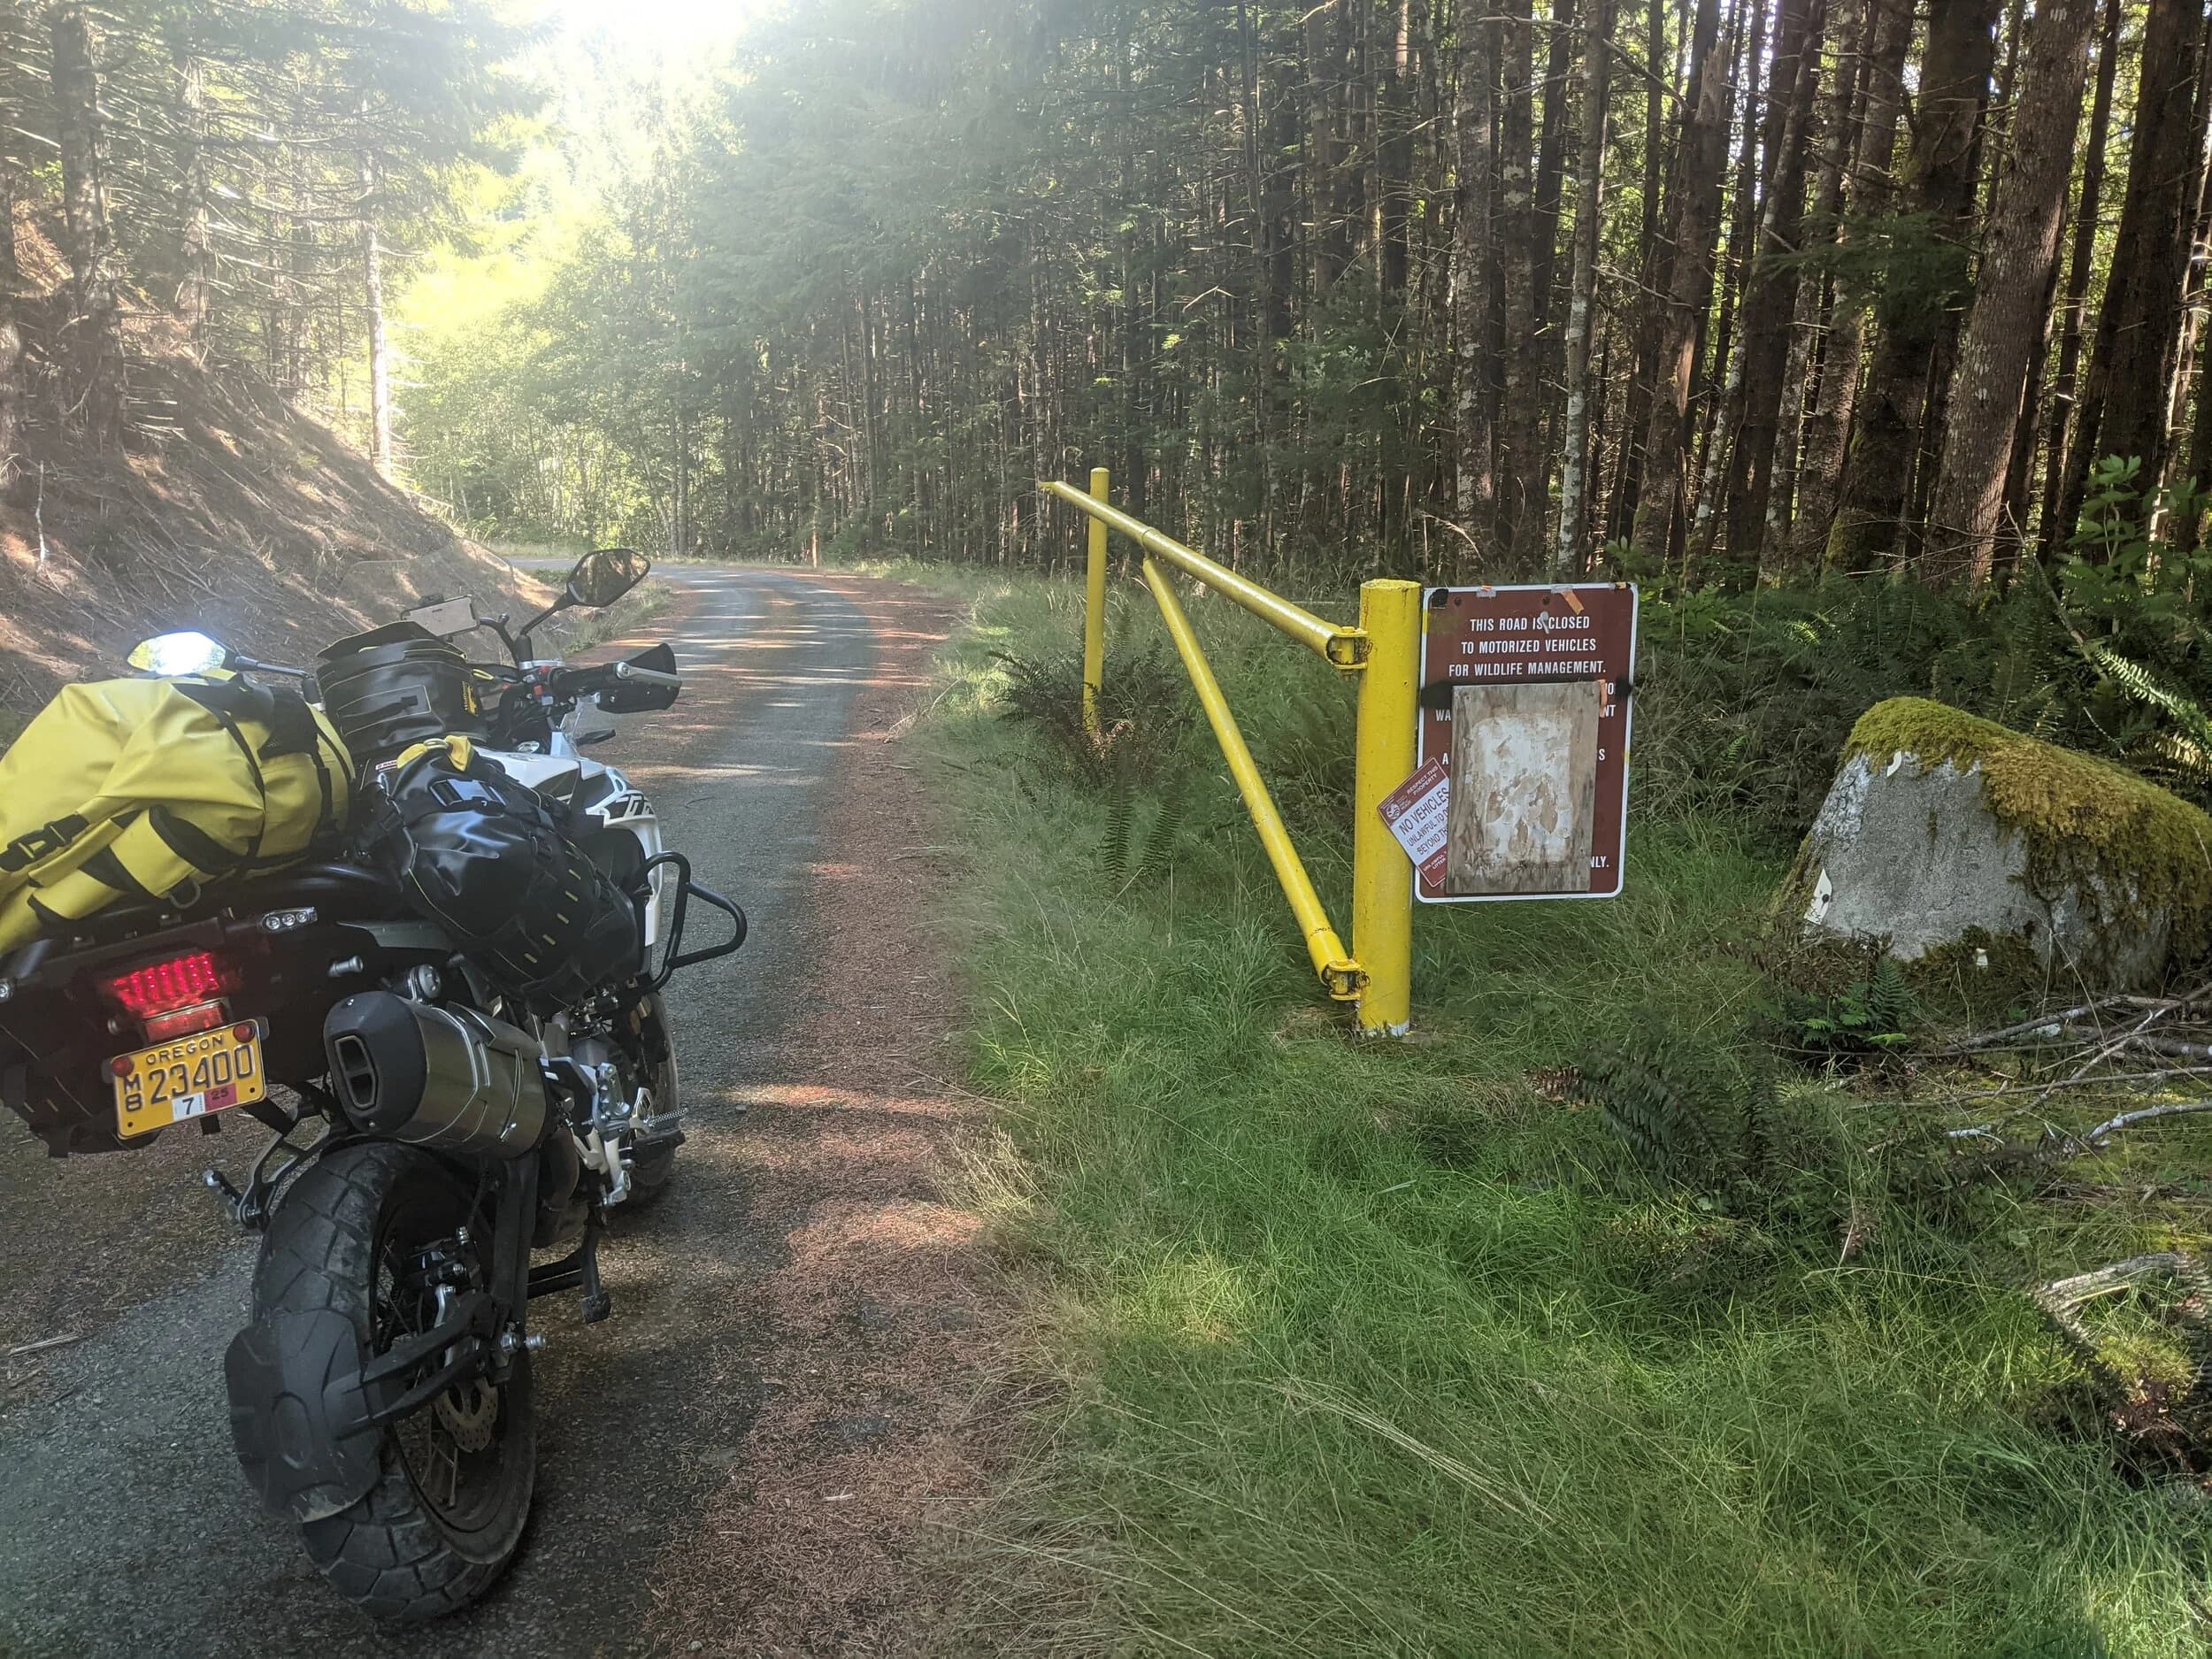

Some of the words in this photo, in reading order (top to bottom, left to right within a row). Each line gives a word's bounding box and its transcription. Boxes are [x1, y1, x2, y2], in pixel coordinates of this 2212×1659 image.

[1470, 618, 1494, 632] THIS
[1499, 617, 1528, 631] ROAD
[1532, 617, 1543, 630] IS
[1548, 616, 1590, 629] CLOSED
[1461, 641, 1474, 655] TO
[1479, 639, 1540, 654] MOTORIZED
[1545, 638, 1596, 652] VEHICLES
[1448, 664, 1469, 677] FOR
[1474, 662, 1523, 676] WILDLIFE
[1528, 661, 1607, 675] MANAGEMENT.
[1407, 773, 1427, 795] RESPECT
[1412, 772, 1438, 796] PROPERTY
[1399, 818, 1414, 835] NO
[1410, 787, 1449, 824] VEHICLES
[1407, 820, 1438, 847] UNLAWFUL
[1433, 813, 1445, 824] TO
[1417, 833, 1440, 856] BEYOND
[146, 1033, 225, 1065] OREGON
[148, 1044, 255, 1105] 23400
[182, 1096, 195, 1115] 7
[211, 1087, 228, 1101] 25
